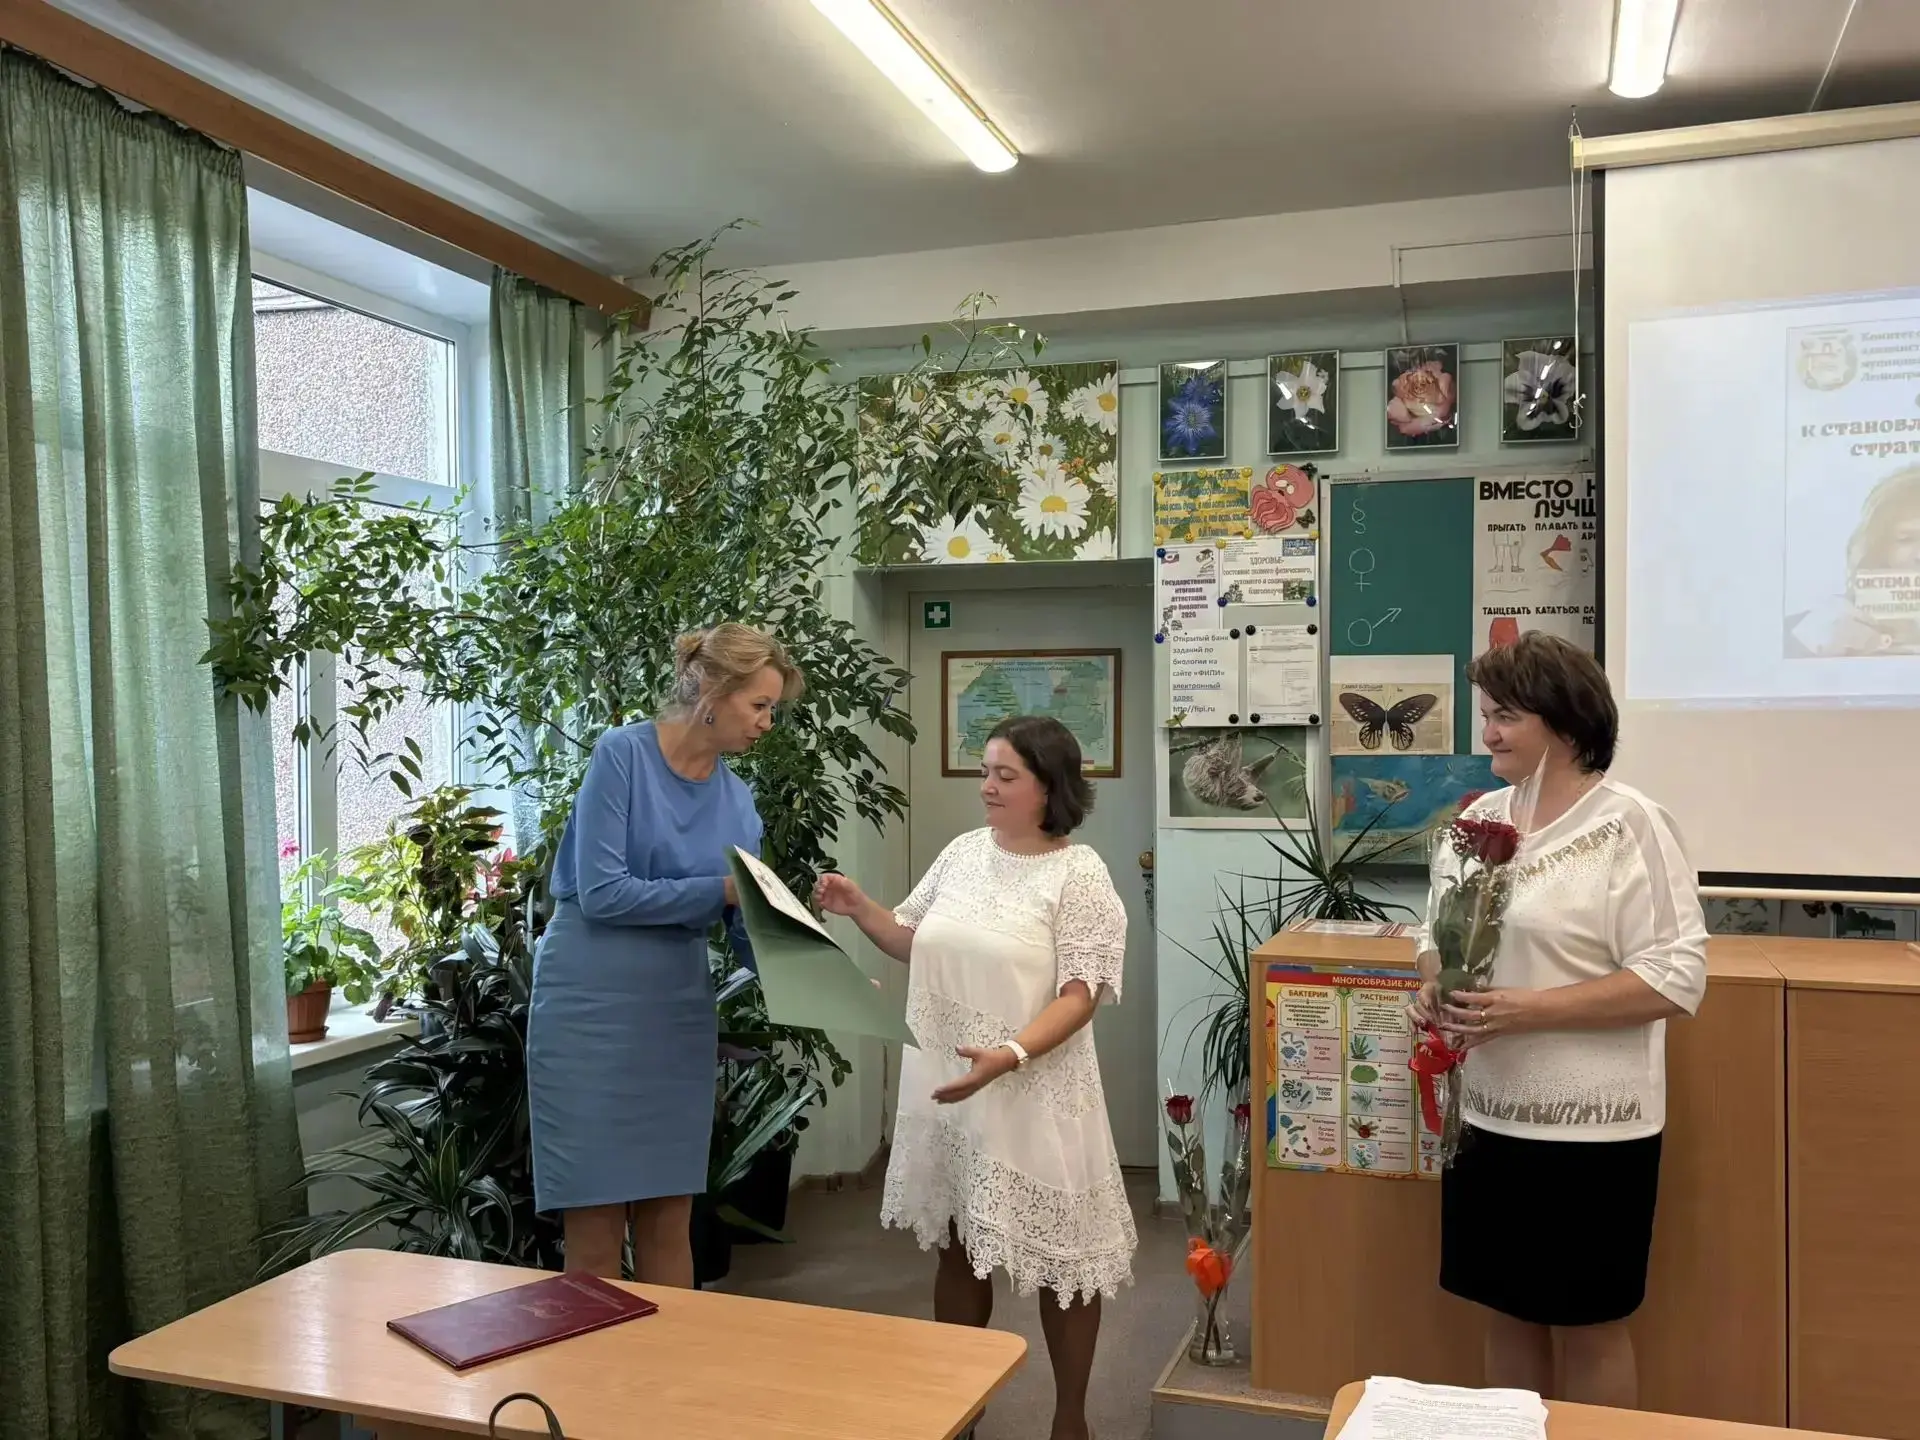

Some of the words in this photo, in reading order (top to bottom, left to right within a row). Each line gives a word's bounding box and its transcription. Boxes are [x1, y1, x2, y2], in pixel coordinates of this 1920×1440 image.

[1801, 424, 1816, 438] к
[1479, 479, 1573, 500] ВМЕСТО
[1534, 498, 1596, 518] ЛУЧШ
[1488, 524, 1526, 532] ПРЫГАТЬ
[1535, 522, 1578, 531] ПЛАВАТЬ
[1482, 606, 1531, 616] ТАНЦЕВАТЬ
[1535, 605, 1580, 614] КАТАТЬСЯ
[1582, 616, 1596, 625] ПЕ
[1173, 634, 1210, 643] Открытый
[1173, 646, 1203, 655] заданий
[1173, 681, 1221, 690] электронный
[1332, 976, 1403, 988] МНОГООБРАЗИЕ
[1288, 989, 1328, 999] БАКТЕРИИ
[1360, 993, 1400, 1002] РАСТЕНИЯ
